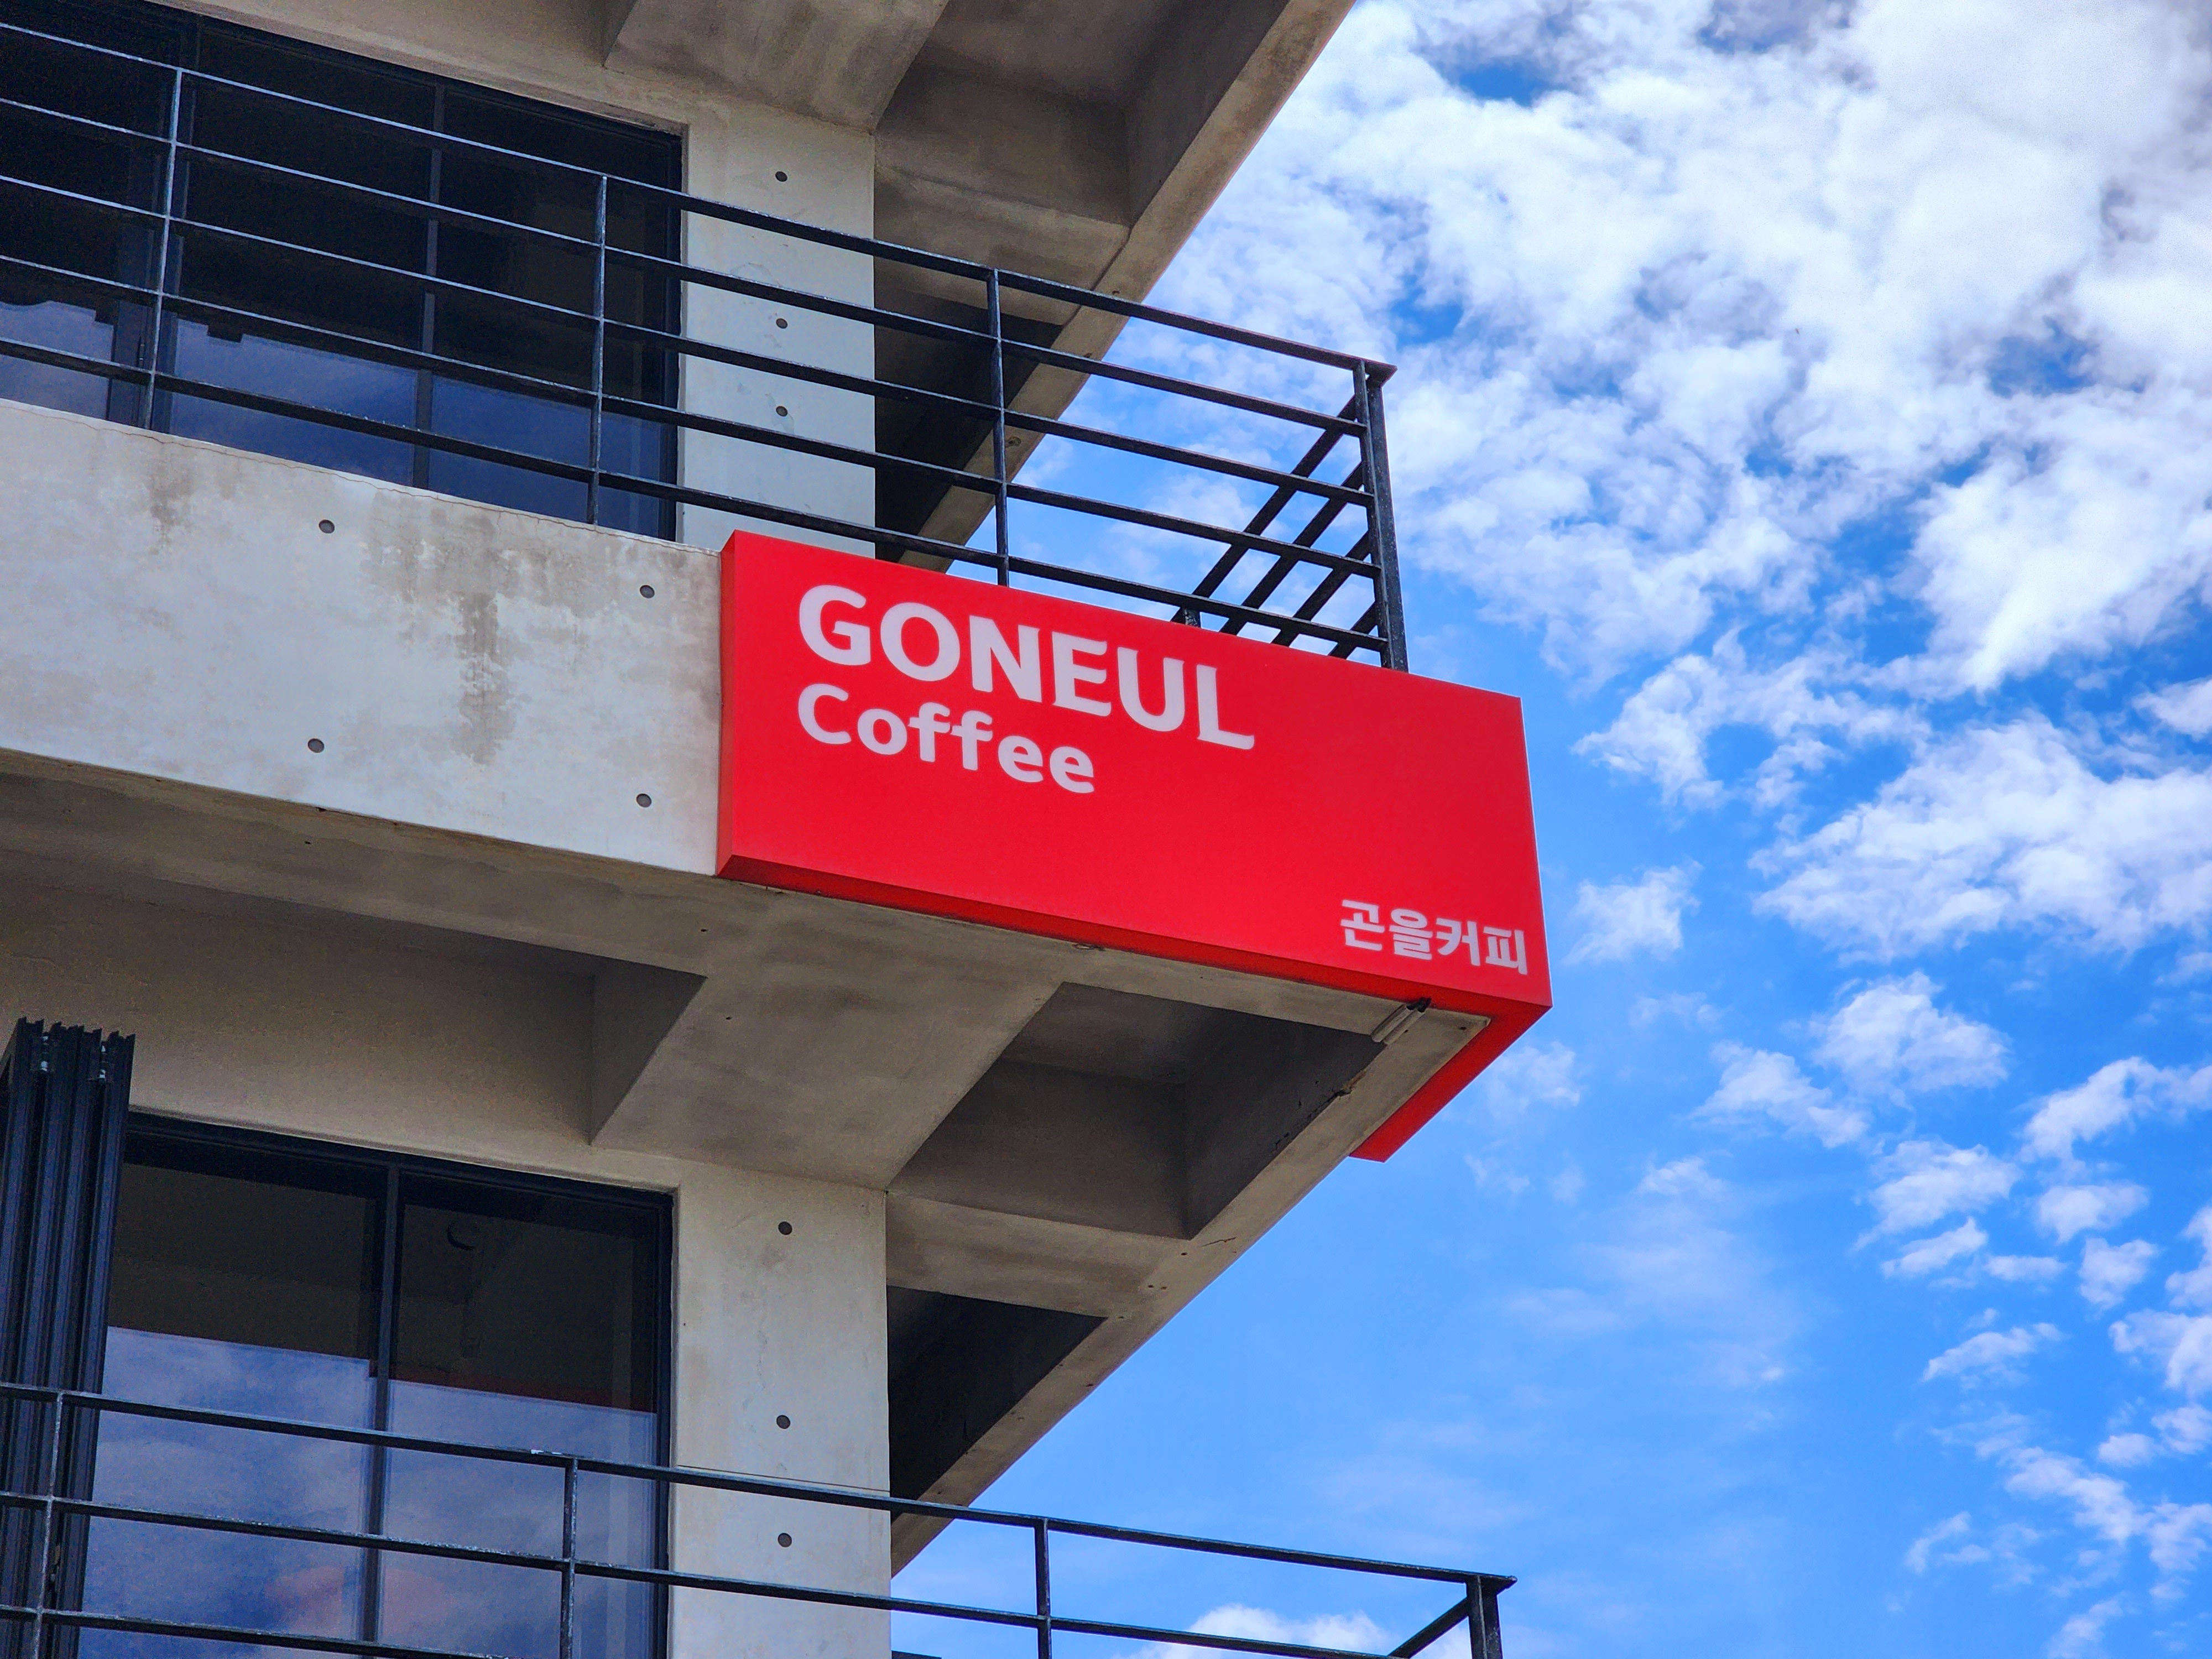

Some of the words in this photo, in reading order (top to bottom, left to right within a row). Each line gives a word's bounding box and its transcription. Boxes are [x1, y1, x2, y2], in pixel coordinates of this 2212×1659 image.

[799, 584, 1255, 750] GONEUL
[797, 683, 1095, 794] Coffee
[1340, 899, 1528, 975] 곤을커피
